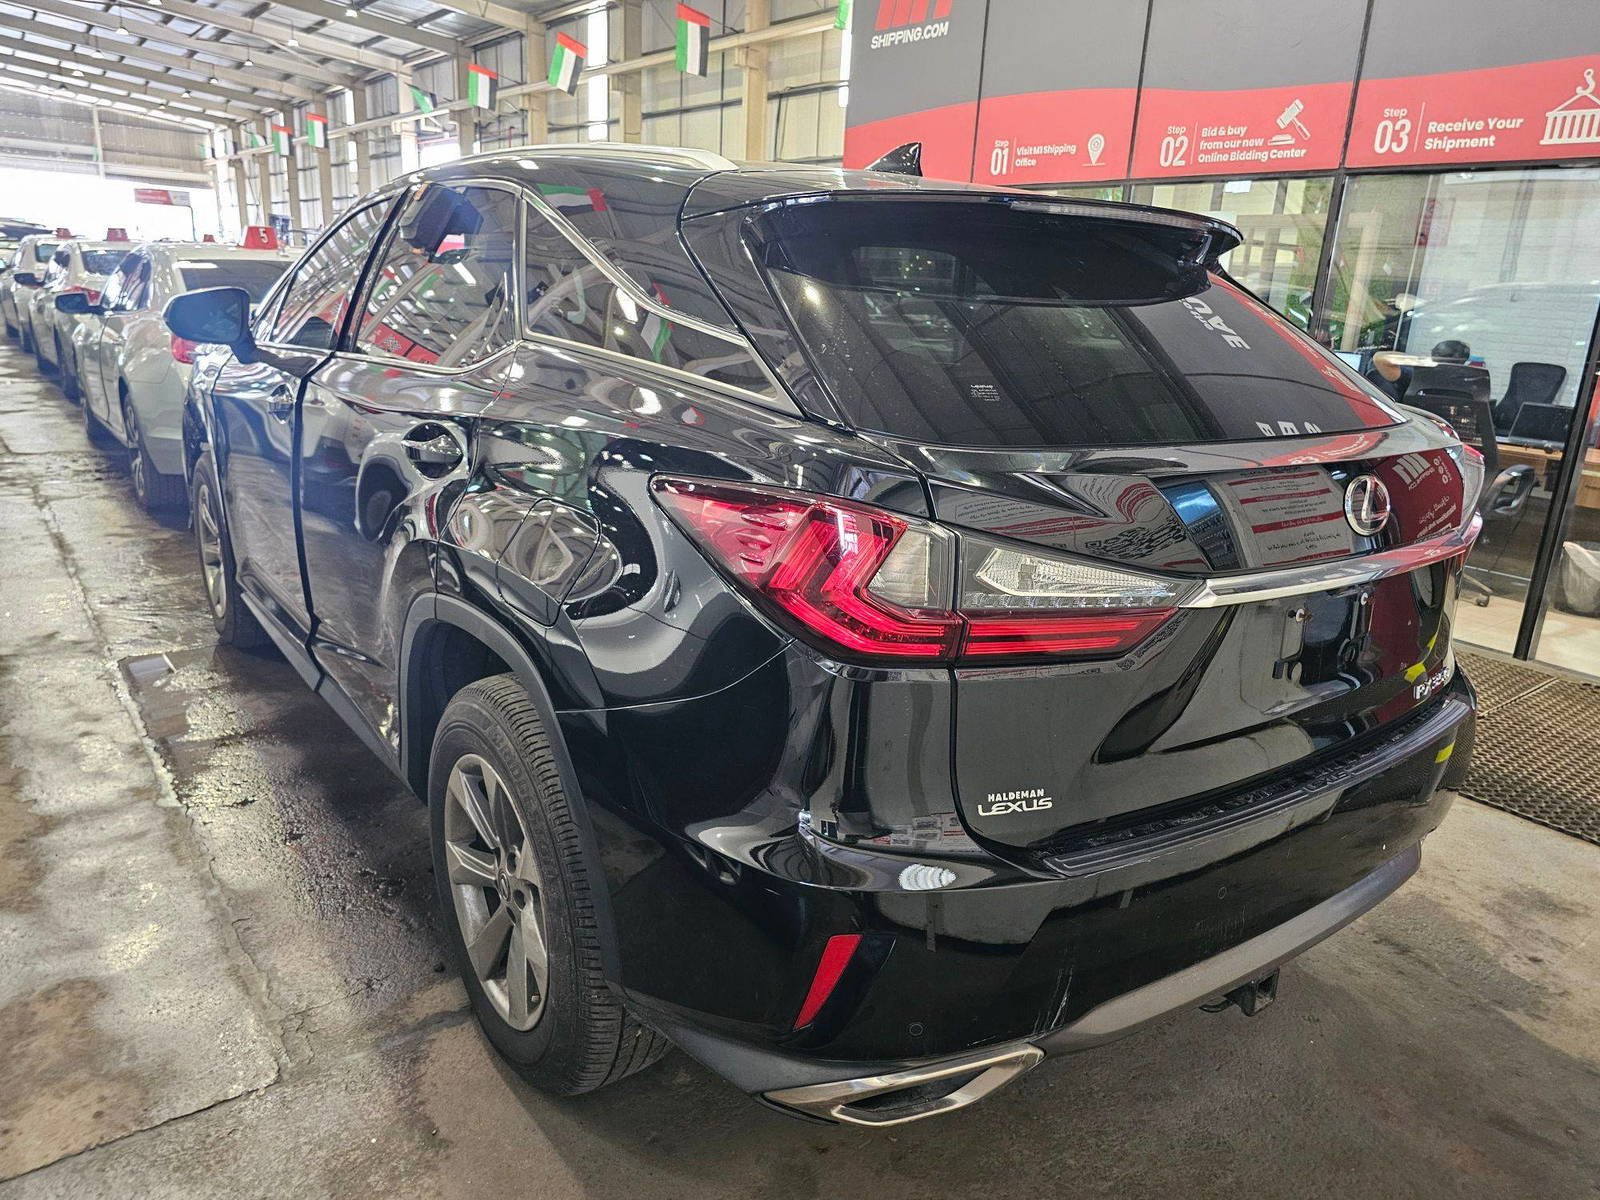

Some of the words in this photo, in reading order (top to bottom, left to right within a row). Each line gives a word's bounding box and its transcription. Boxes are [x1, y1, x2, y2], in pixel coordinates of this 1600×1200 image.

[871, 21, 949, 49] SHIPPING.COM
[1384, 108, 1407, 119] Step
[1167, 126, 1187, 136] Step
[1202, 127, 1217, 137] Bid
[1218, 126, 1225, 136] &
[1227, 125, 1248, 137] buy
[1428, 119, 1485, 133] Receive
[1487, 117, 1524, 129] Your
[1374, 119, 1411, 154] 03
[1424, 135, 1496, 152] Shipment
[1017, 146, 1033, 155] Visit
[1043, 144, 1076, 155] Shipping
[1160, 136, 1189, 167] 02
[1200, 140, 1224, 150] from
[1224, 140, 1242, 149] our
[991, 148, 1008, 175] 01
[1015, 158, 1037, 167] Office
[1198, 153, 1230, 163] Online
[1230, 150, 1268, 162] Bidding
[1270, 148, 1306, 160] Center
[259, 227, 269, 244] 5
[987, 788, 1045, 802] HALDEMAN
[977, 797, 1053, 816] LEXUS
